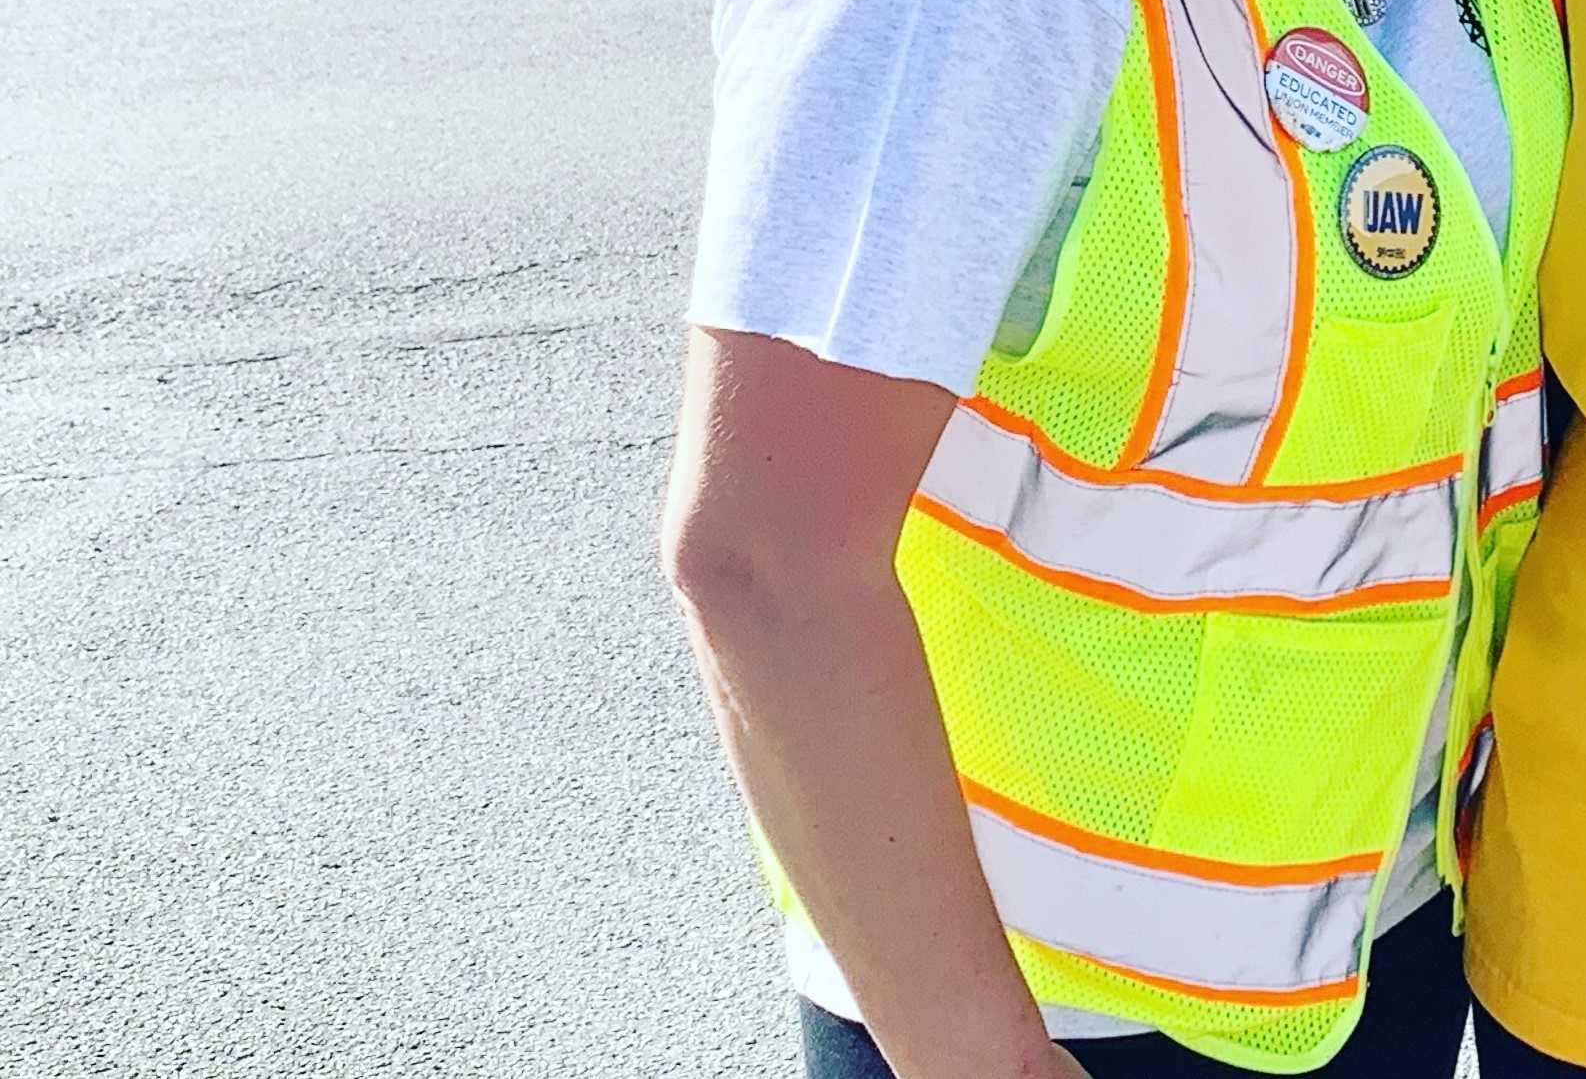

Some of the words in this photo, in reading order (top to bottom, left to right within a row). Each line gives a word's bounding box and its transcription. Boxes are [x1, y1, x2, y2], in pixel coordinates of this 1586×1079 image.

[1294, 45, 1358, 90] DANGER
[1274, 88, 1308, 114] UNION
[1309, 108, 1354, 139] MEMBER
[1279, 72, 1357, 126] EDUCATED
[1362, 189, 1425, 236] UAW
